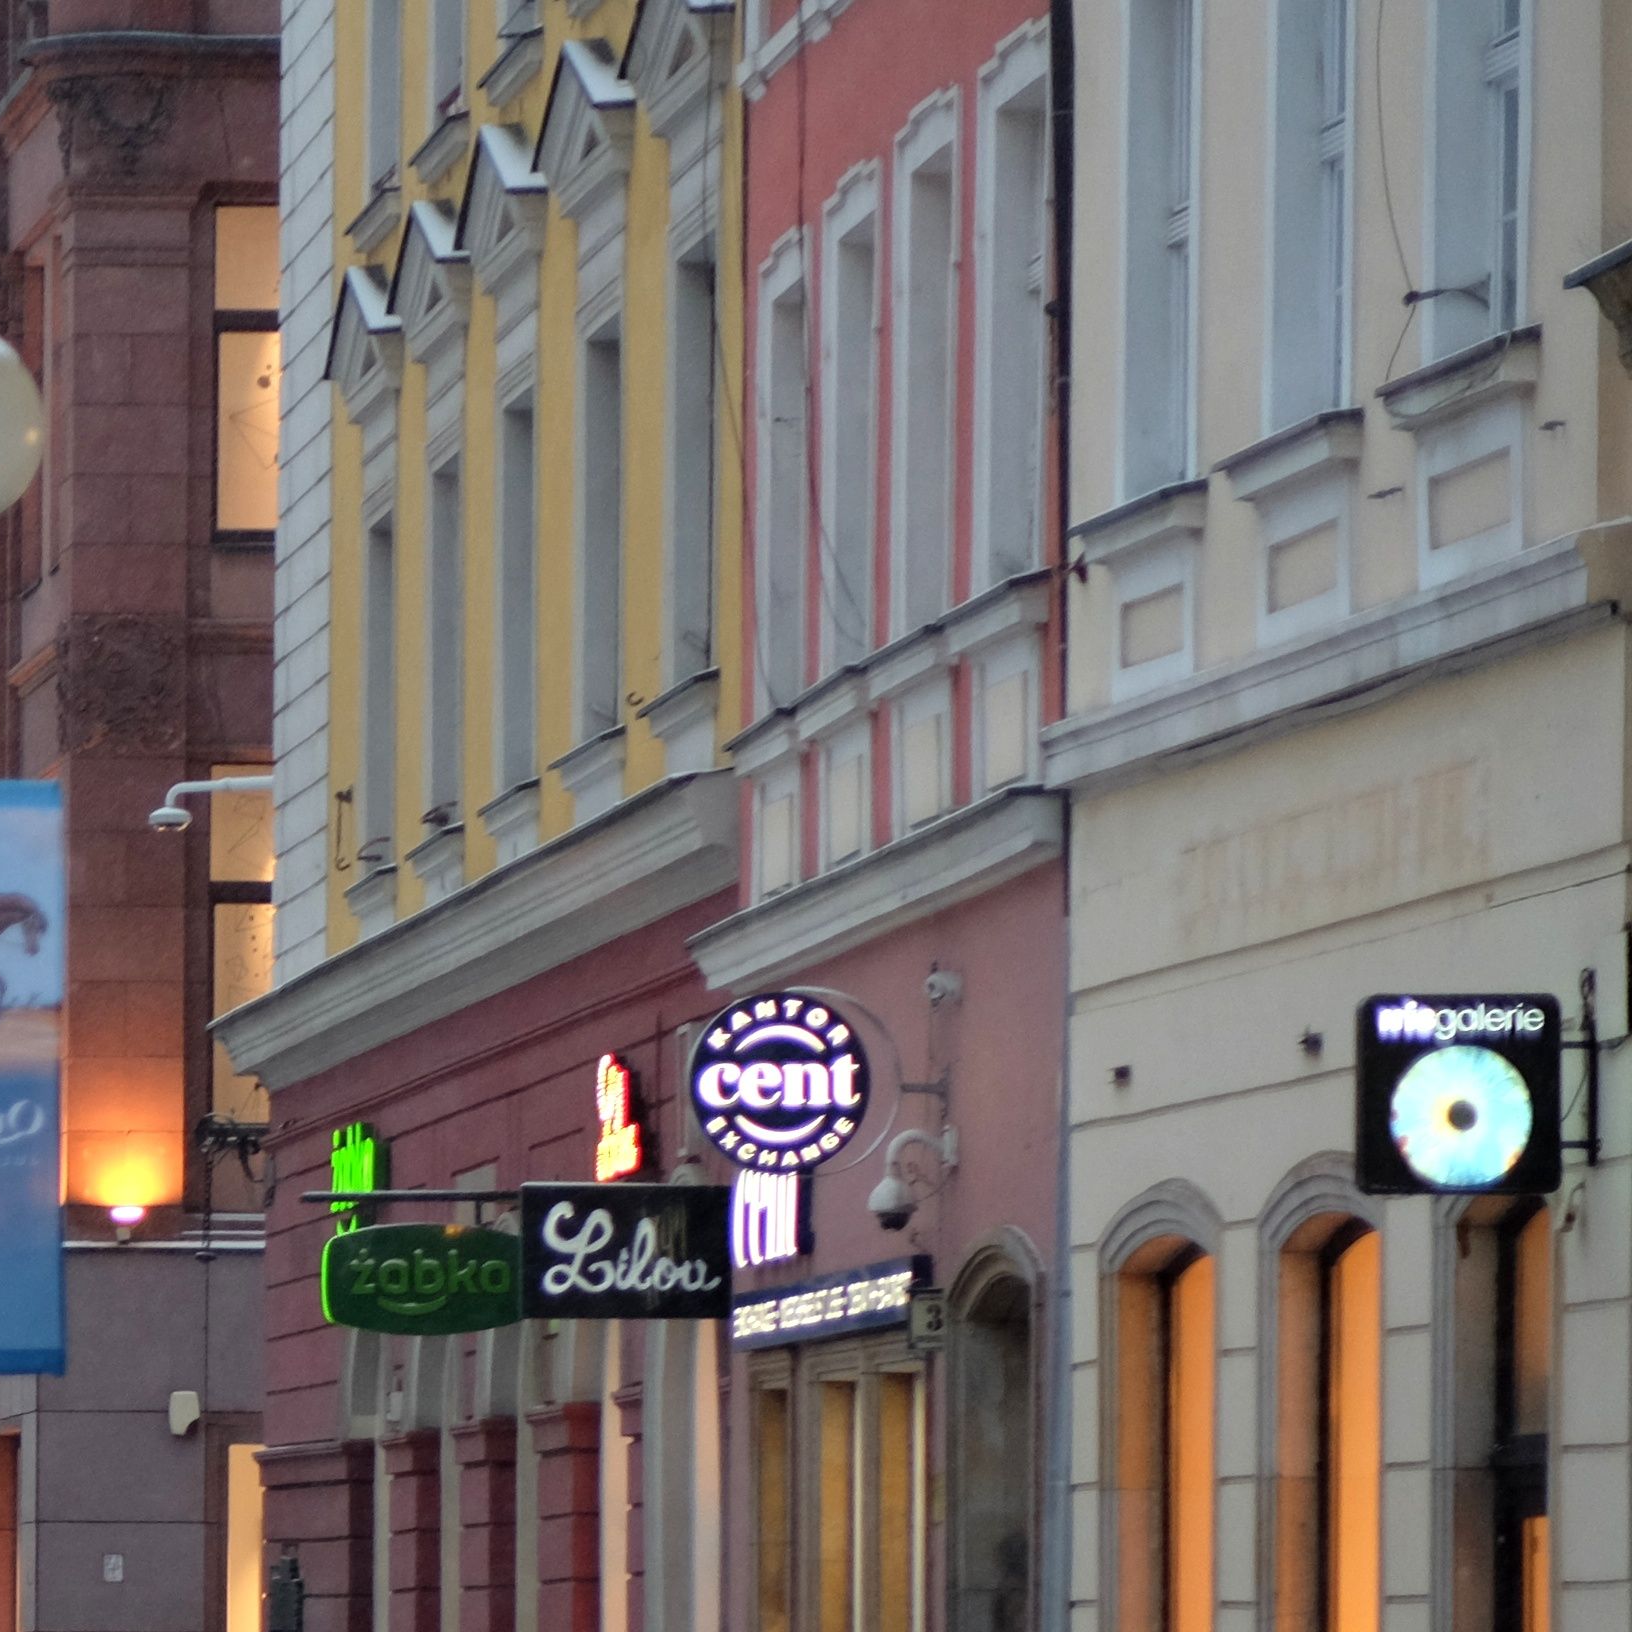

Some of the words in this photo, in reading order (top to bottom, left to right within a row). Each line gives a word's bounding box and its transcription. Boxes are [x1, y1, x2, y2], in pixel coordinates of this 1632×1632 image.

[707, 998, 850, 1050] KANTOR
[697, 1053, 862, 1108] cent
[706, 1116, 855, 1168] EXCHANGE
[348, 1247, 511, 1296] żabka
[542, 1200, 722, 1296] Lilou
[926, 1304, 944, 1331] 3
